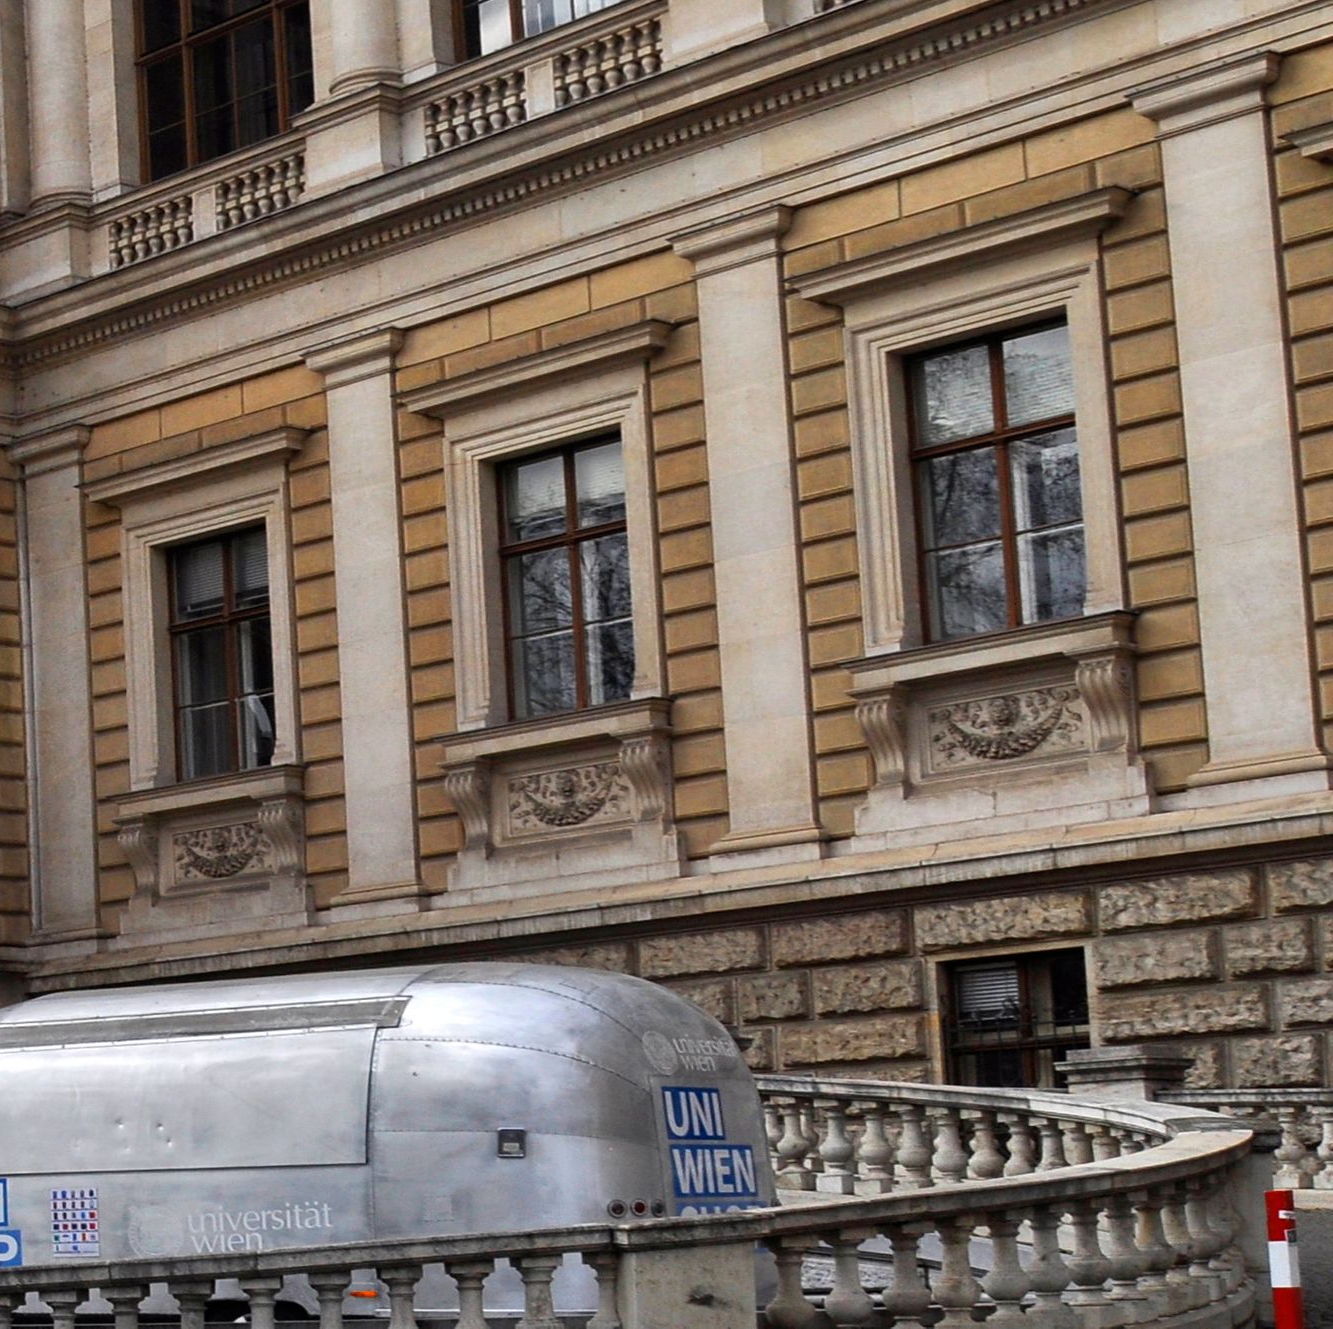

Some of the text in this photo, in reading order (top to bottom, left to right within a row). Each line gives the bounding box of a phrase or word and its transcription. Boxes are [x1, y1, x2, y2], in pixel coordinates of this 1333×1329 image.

[664, 1090, 724, 1137] UNI
[671, 1148, 757, 1195] WIEN
[187, 1200, 334, 1233] universität
[190, 1230, 263, 1254] wien
